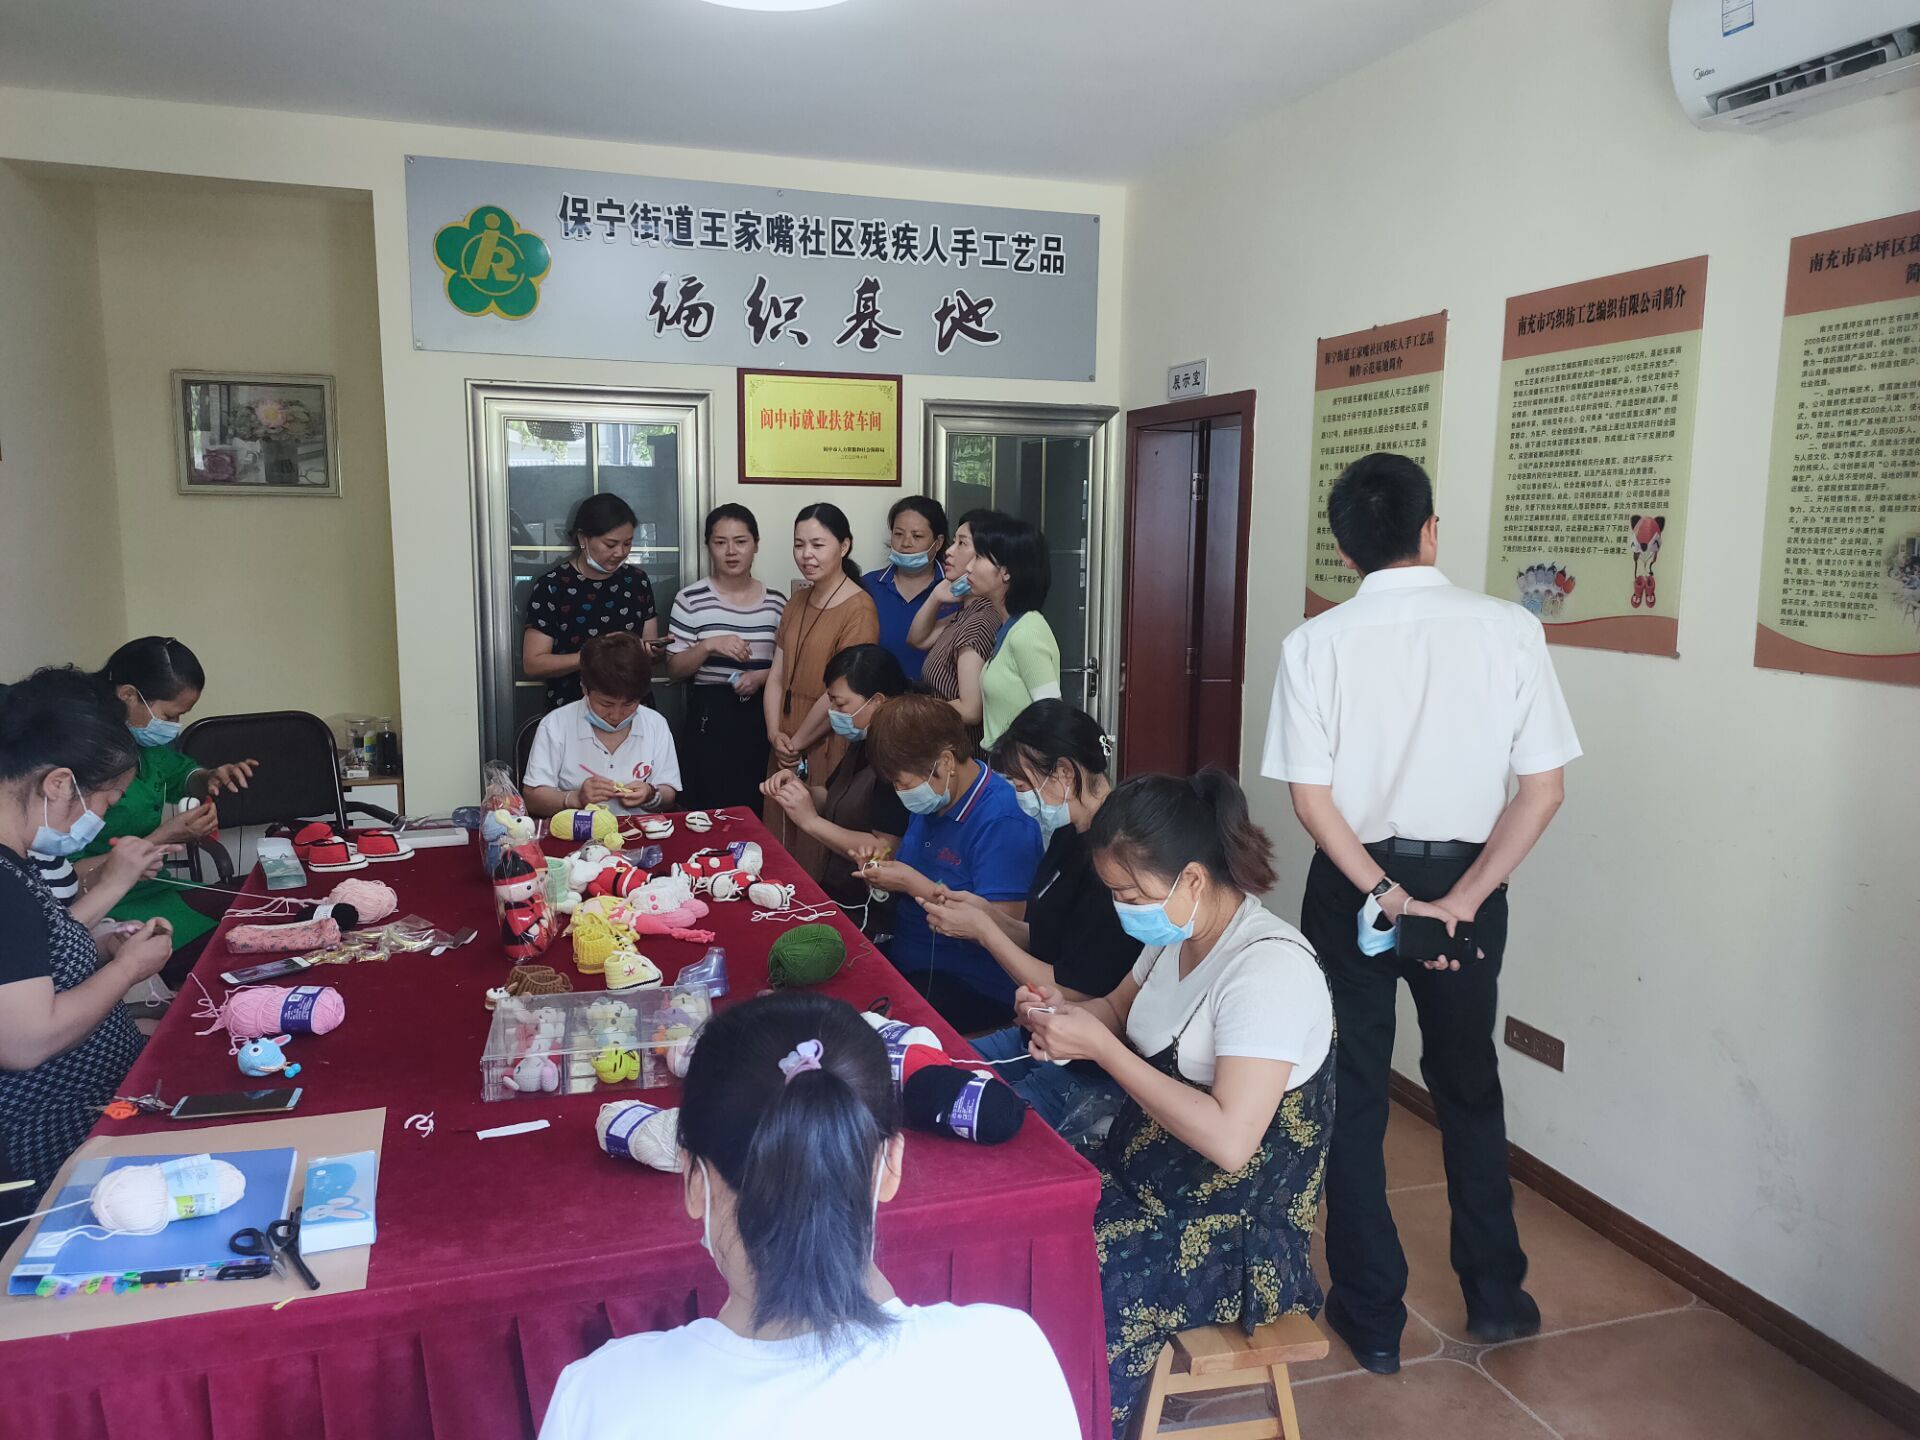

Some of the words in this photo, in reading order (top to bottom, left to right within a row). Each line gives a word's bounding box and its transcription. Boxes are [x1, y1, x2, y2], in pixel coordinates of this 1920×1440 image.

[558, 194, 1067, 277] 保宁街道王家嘴社区残疾人手工艺品
[648, 273, 1001, 354] 编织基地
[1517, 282, 1687, 336] 南充市巧织坊工艺编织有限公司简介
[760, 408, 882, 432] 阆中市就业扶贫车间
